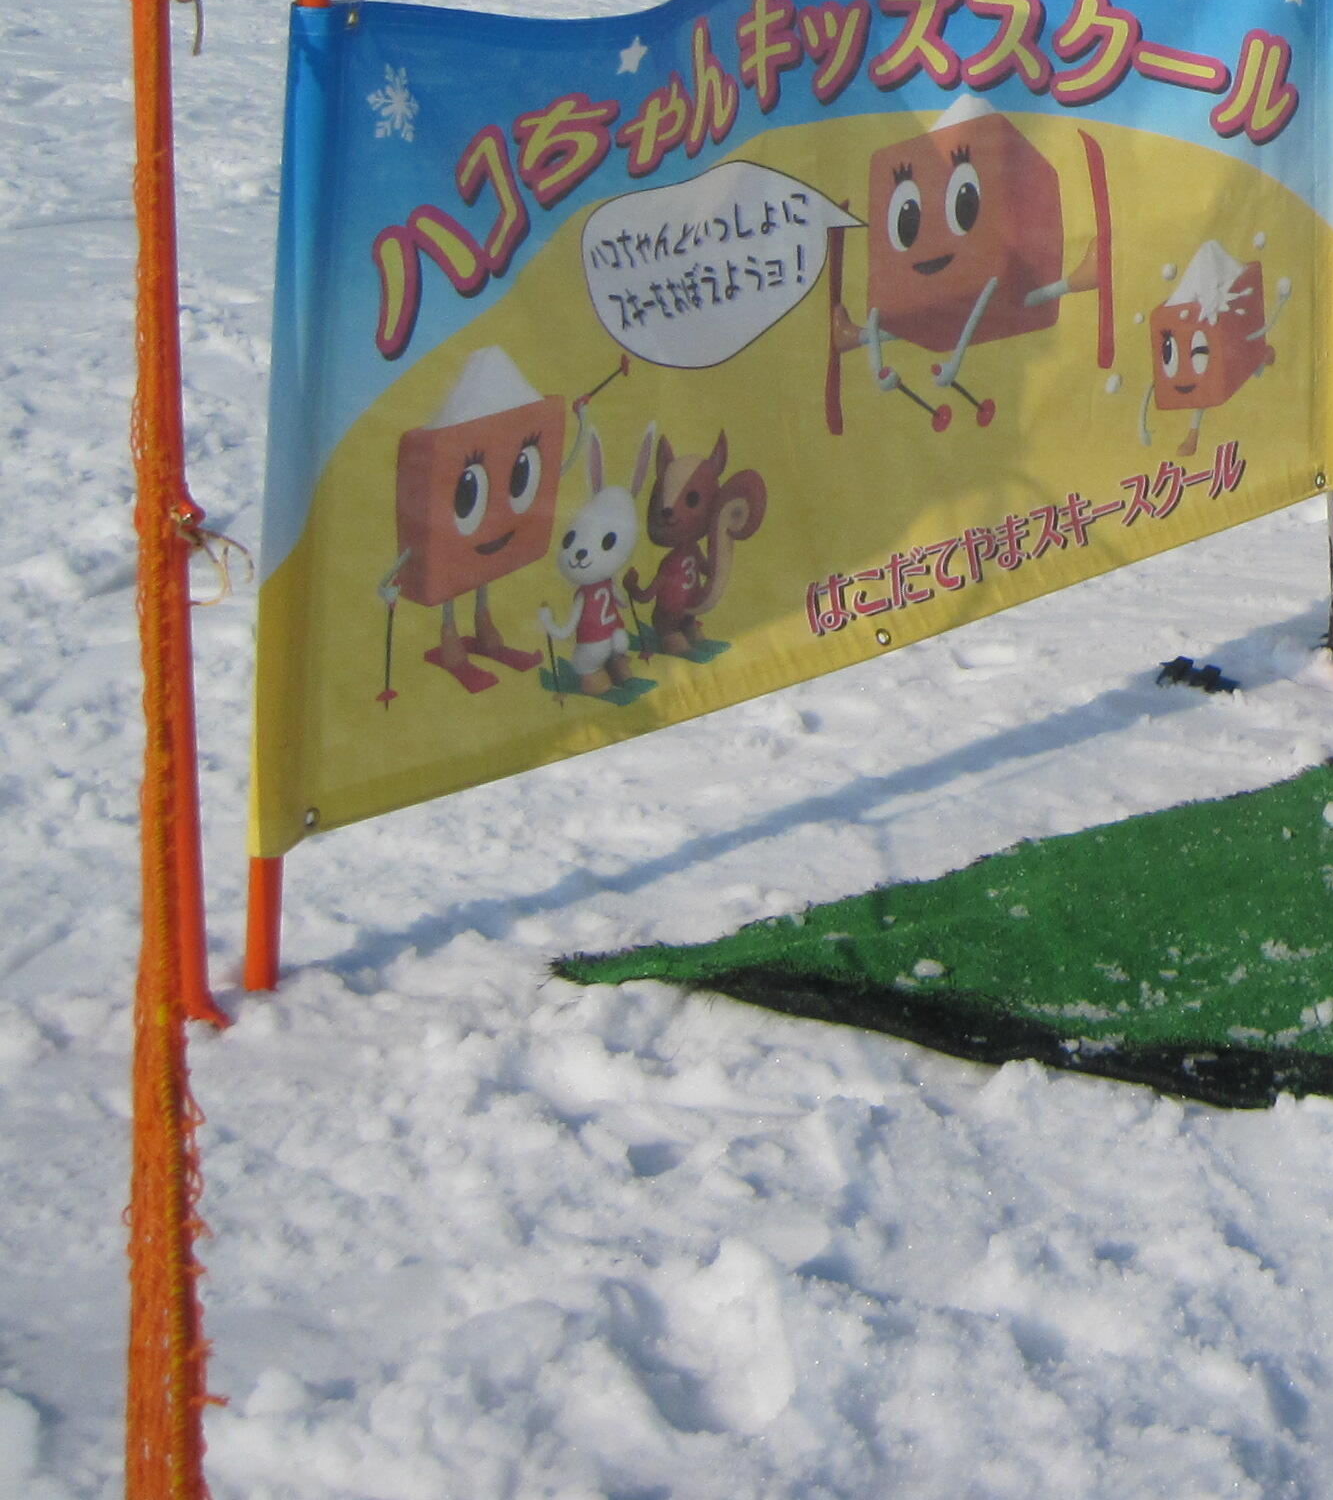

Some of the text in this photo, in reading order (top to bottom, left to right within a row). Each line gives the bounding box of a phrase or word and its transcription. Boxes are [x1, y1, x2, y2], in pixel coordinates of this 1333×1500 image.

[804, 440, 1247, 634] はこだてやまスキースクール
[681, 555, 697, 591] 3
[594, 587, 618, 626] 2
